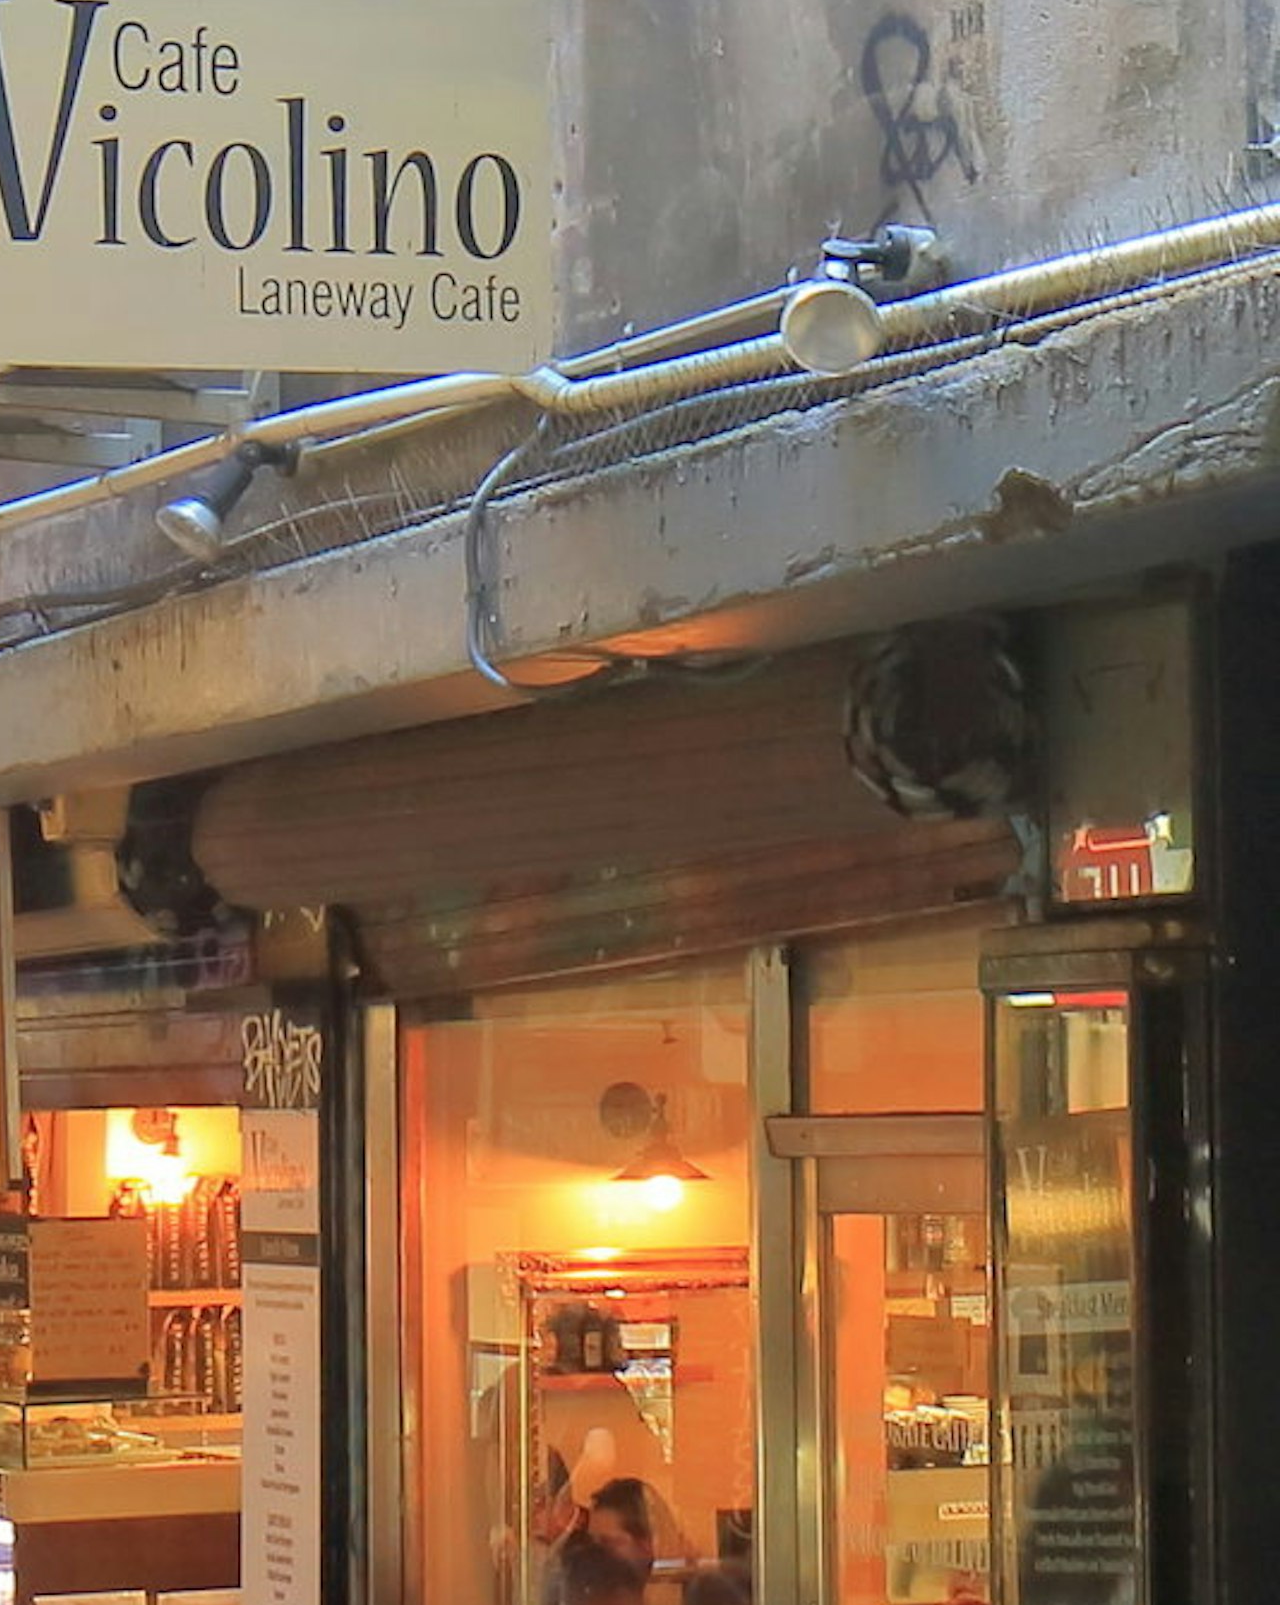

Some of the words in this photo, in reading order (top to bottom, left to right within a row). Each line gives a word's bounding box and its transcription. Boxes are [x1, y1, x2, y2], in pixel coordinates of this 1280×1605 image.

[113, 20, 240, 95] Cafe
[239, 266, 413, 330] Laneway
[432, 272, 522, 323] Cafe
